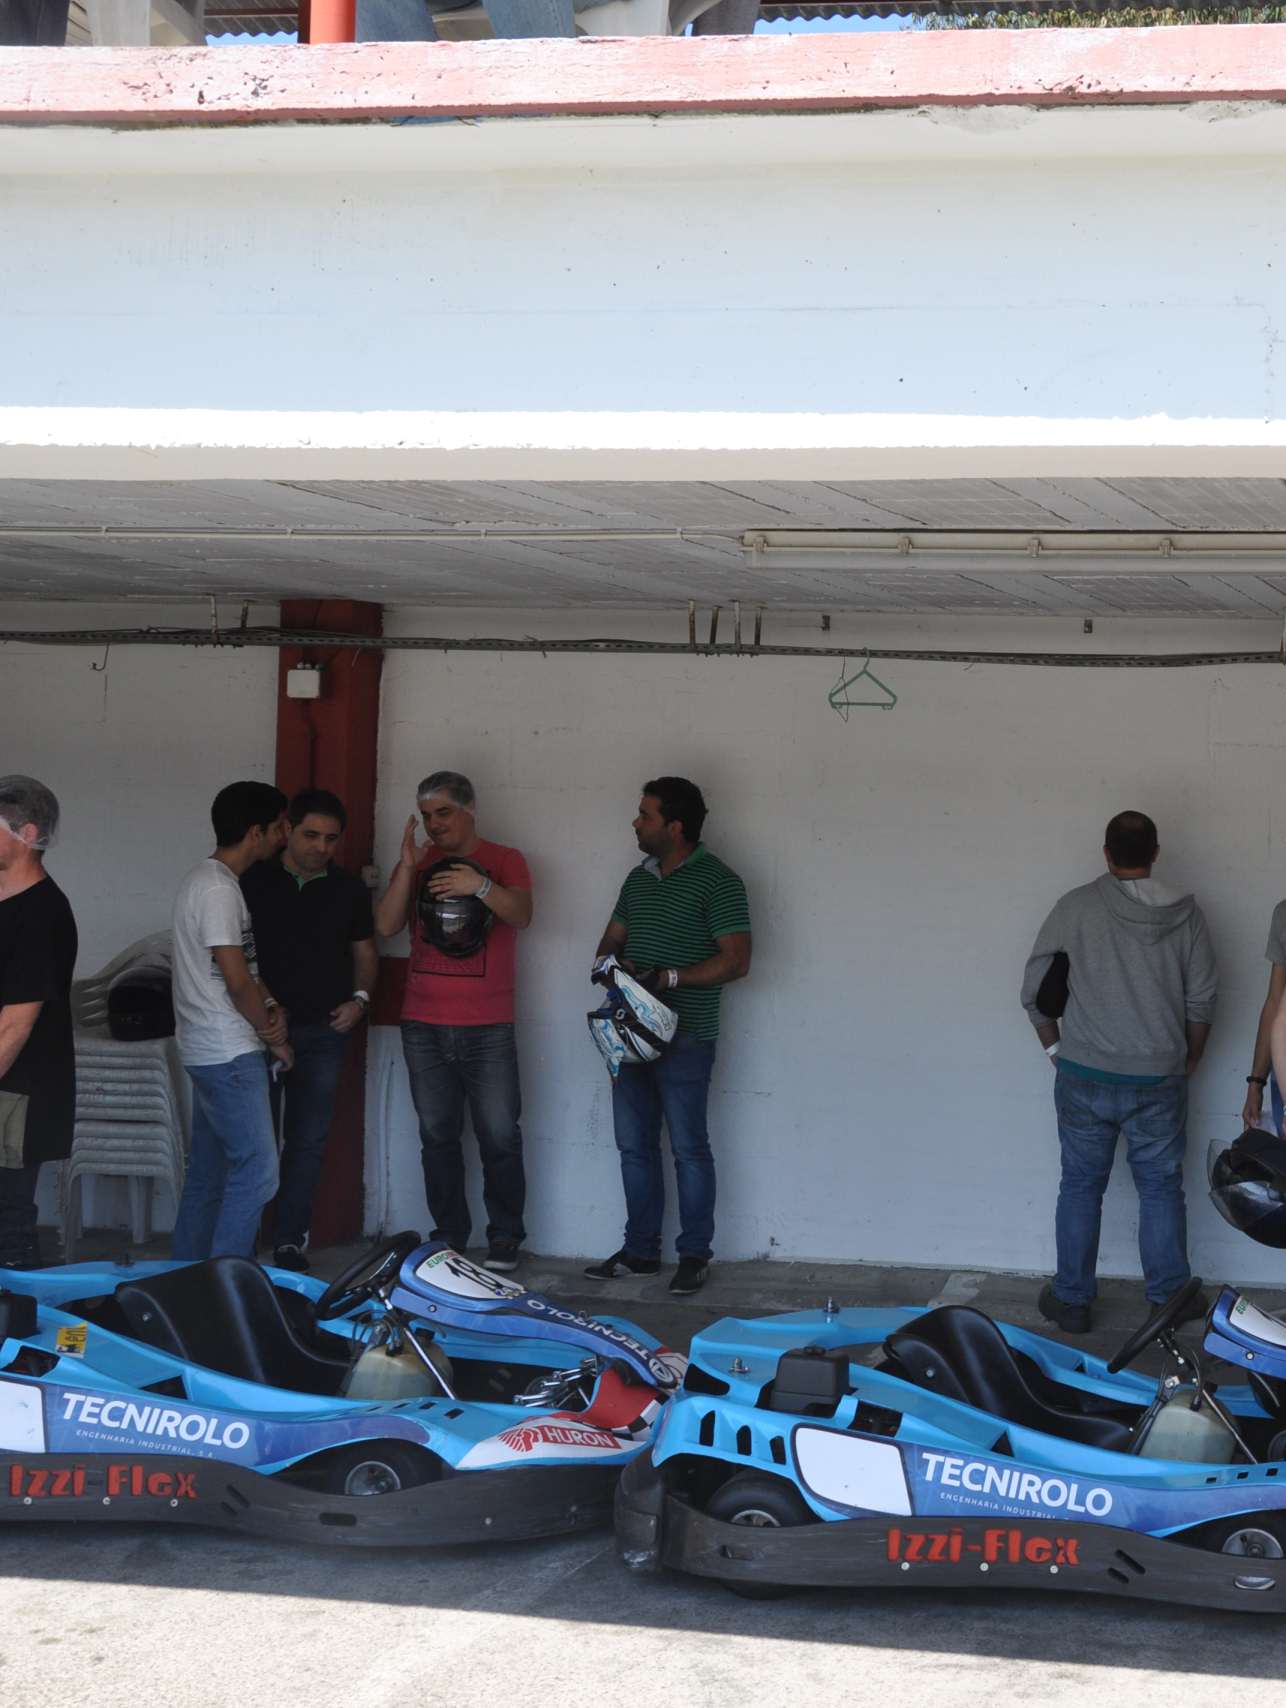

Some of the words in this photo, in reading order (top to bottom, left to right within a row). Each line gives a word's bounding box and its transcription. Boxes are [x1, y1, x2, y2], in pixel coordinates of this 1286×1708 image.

[445, 1257, 505, 1292] 18
[63, 1392, 250, 1450] TECNIROLO
[76, 1429, 135, 1445] ENGENHARIA
[545, 1426, 615, 1448] HURON
[921, 1452, 1113, 1517] TECNIROLO
[940, 1492, 999, 1511] ENGENHARIA
